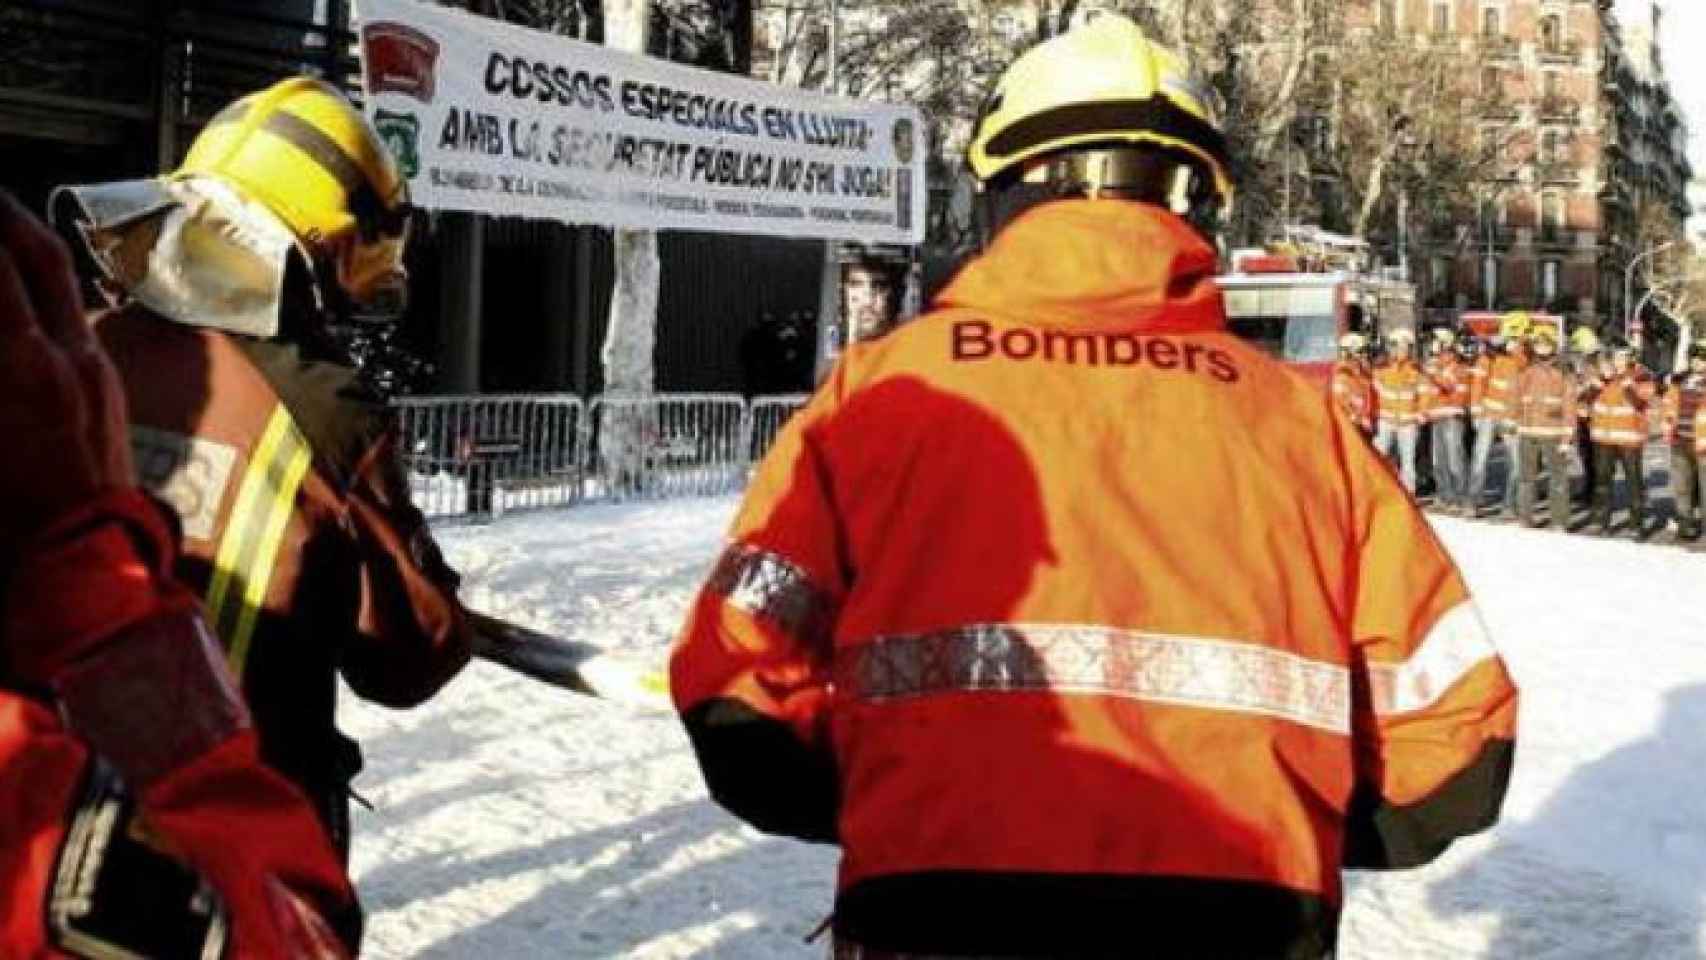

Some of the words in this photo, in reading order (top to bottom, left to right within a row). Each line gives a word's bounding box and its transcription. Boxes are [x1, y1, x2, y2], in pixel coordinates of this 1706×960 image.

[439, 105, 503, 155] AMB
[775, 156, 803, 194] NO
[762, 108, 798, 142] EN
[951, 319, 1240, 384] Bombers
